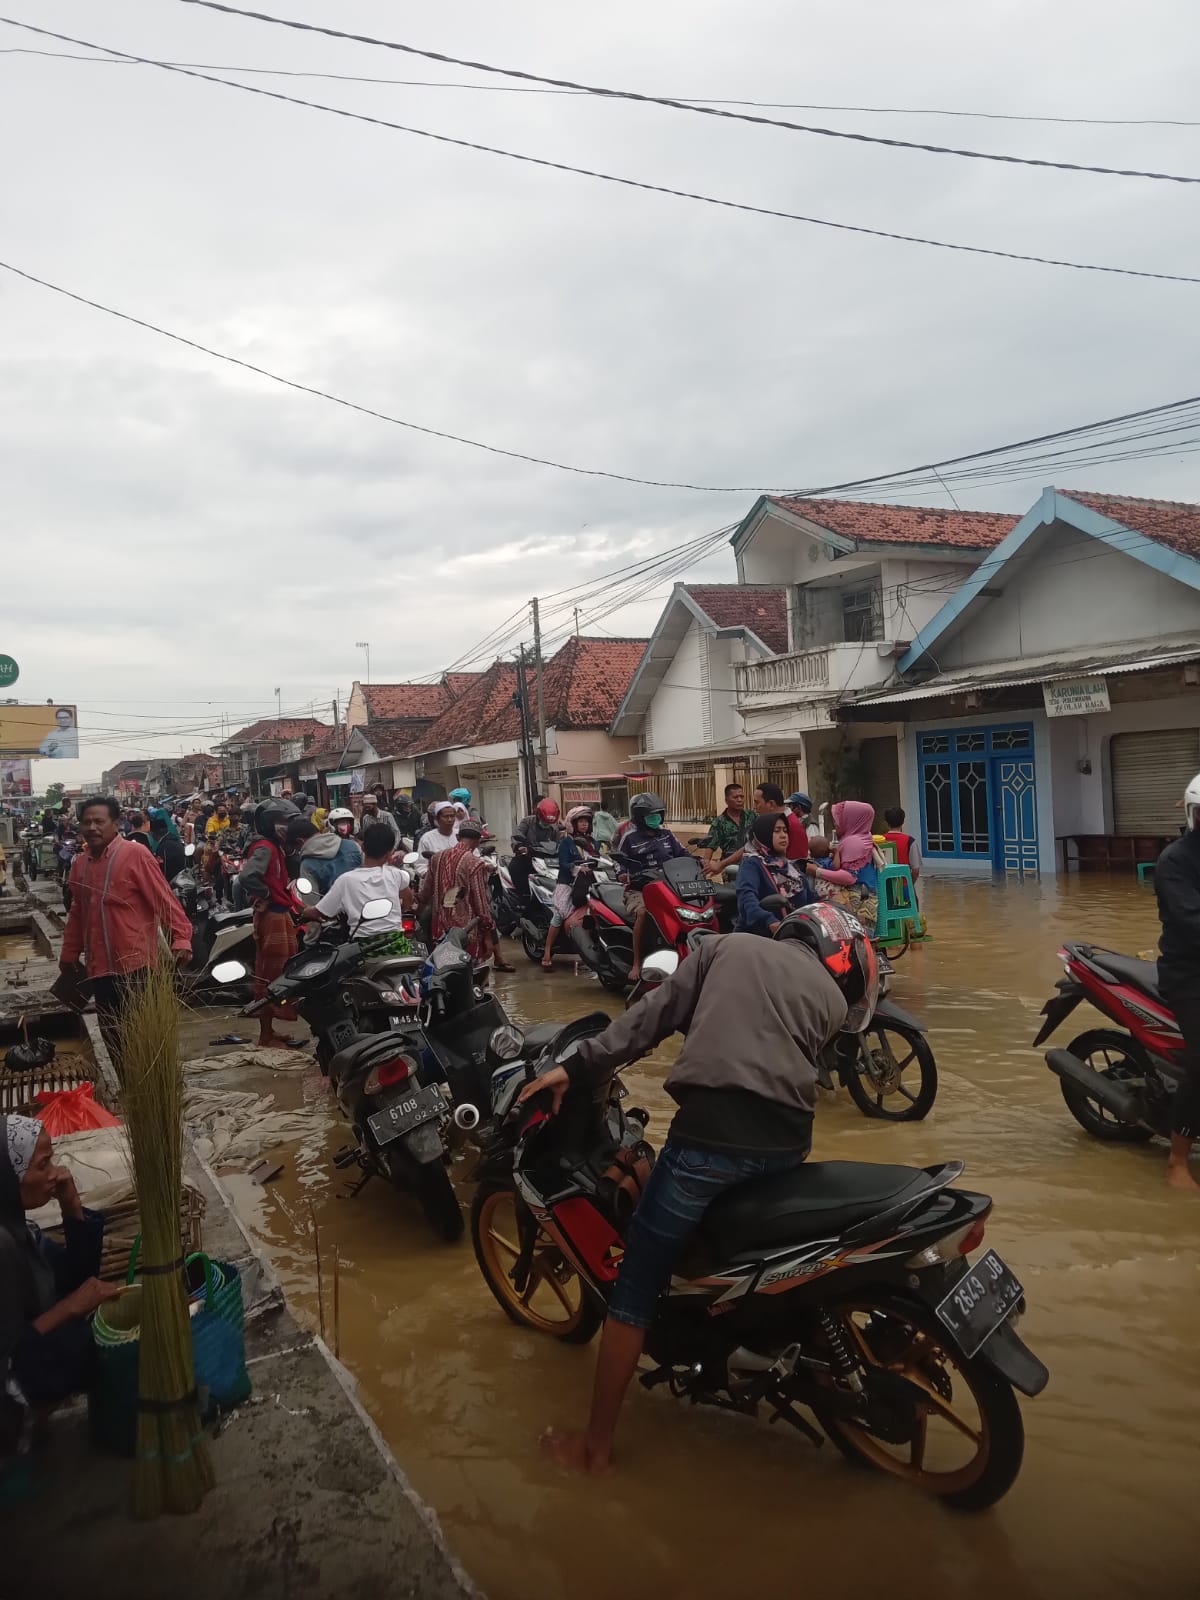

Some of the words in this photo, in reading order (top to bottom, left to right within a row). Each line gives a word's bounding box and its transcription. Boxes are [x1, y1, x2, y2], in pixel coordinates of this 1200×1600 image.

[371, 1119, 381, 1130] L
[389, 1099, 418, 1120] 6708
[430, 1086, 439, 1098] V
[942, 1311, 959, 1330] L
[954, 1276, 985, 1315] 2649
[985, 1255, 1003, 1280] JB
